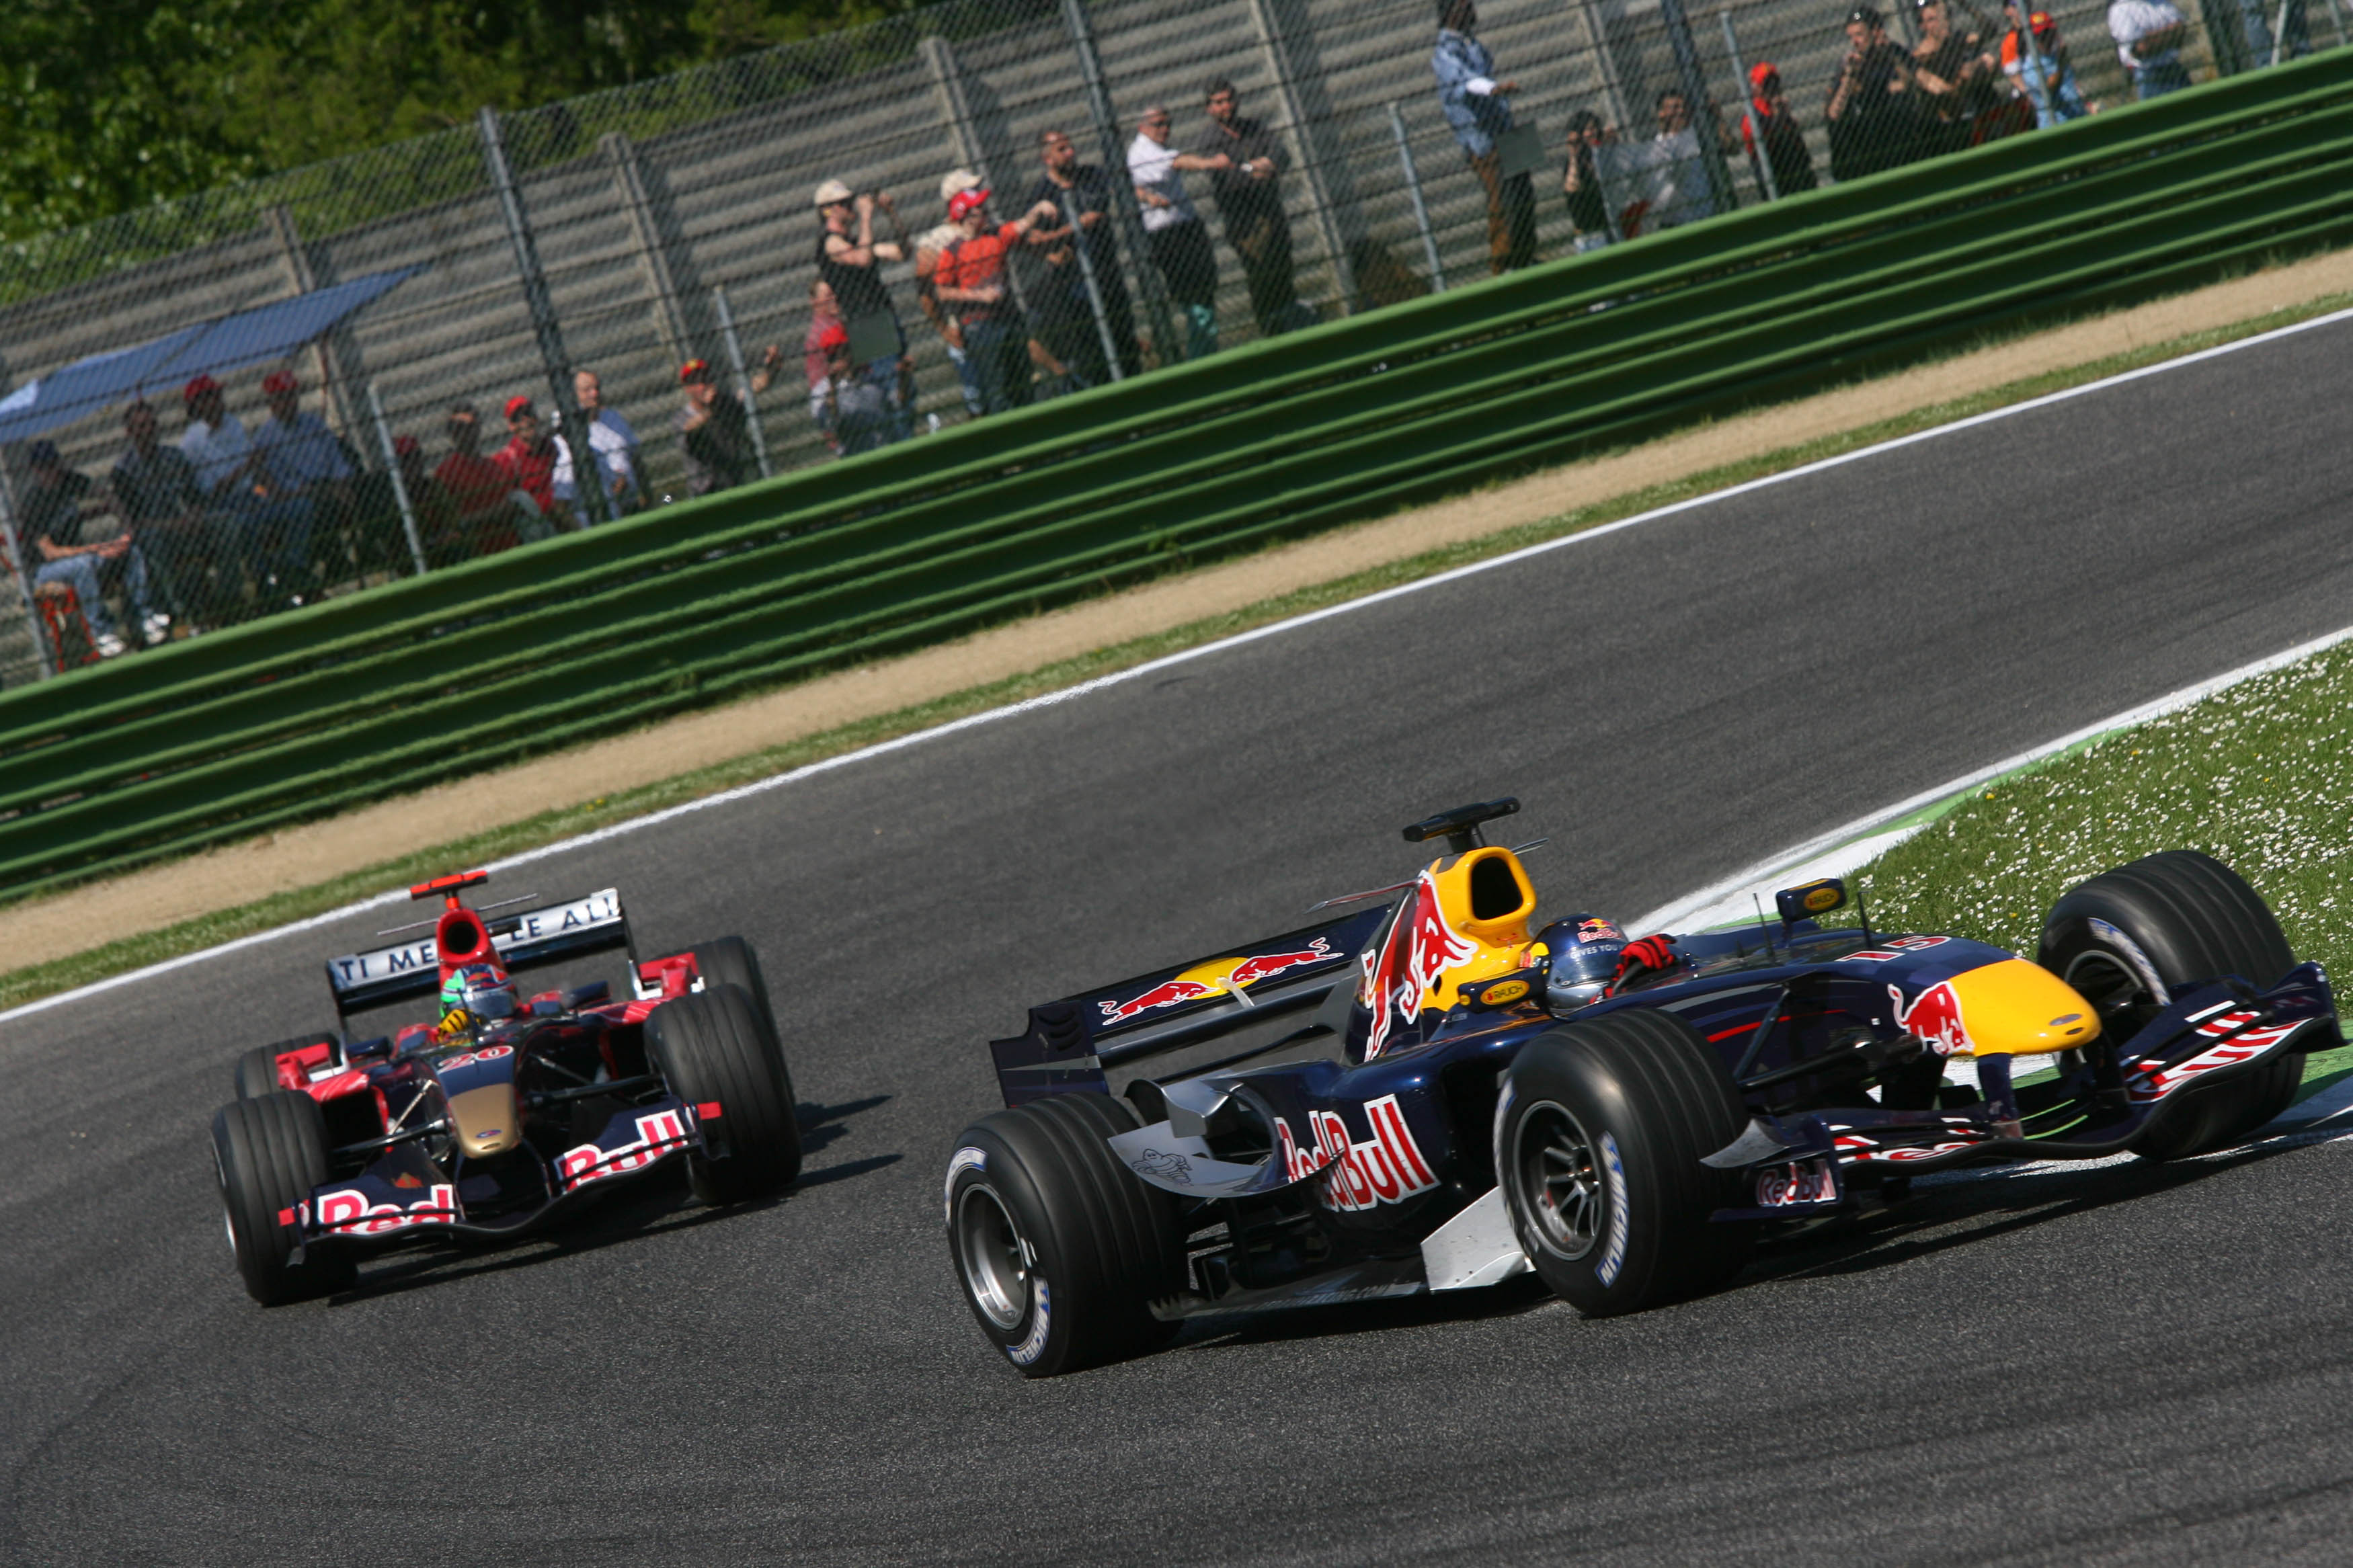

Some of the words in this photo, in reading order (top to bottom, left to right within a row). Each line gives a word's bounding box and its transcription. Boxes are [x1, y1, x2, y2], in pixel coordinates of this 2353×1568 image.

[1834, 935, 1952, 962] 15
[339, 958, 369, 981] TI
[437, 1045, 514, 1075] 20
[553, 1108, 688, 1195] Bull
[317, 1184, 455, 1235] Red
[1599, 1170, 1629, 1286] MICHELIN
